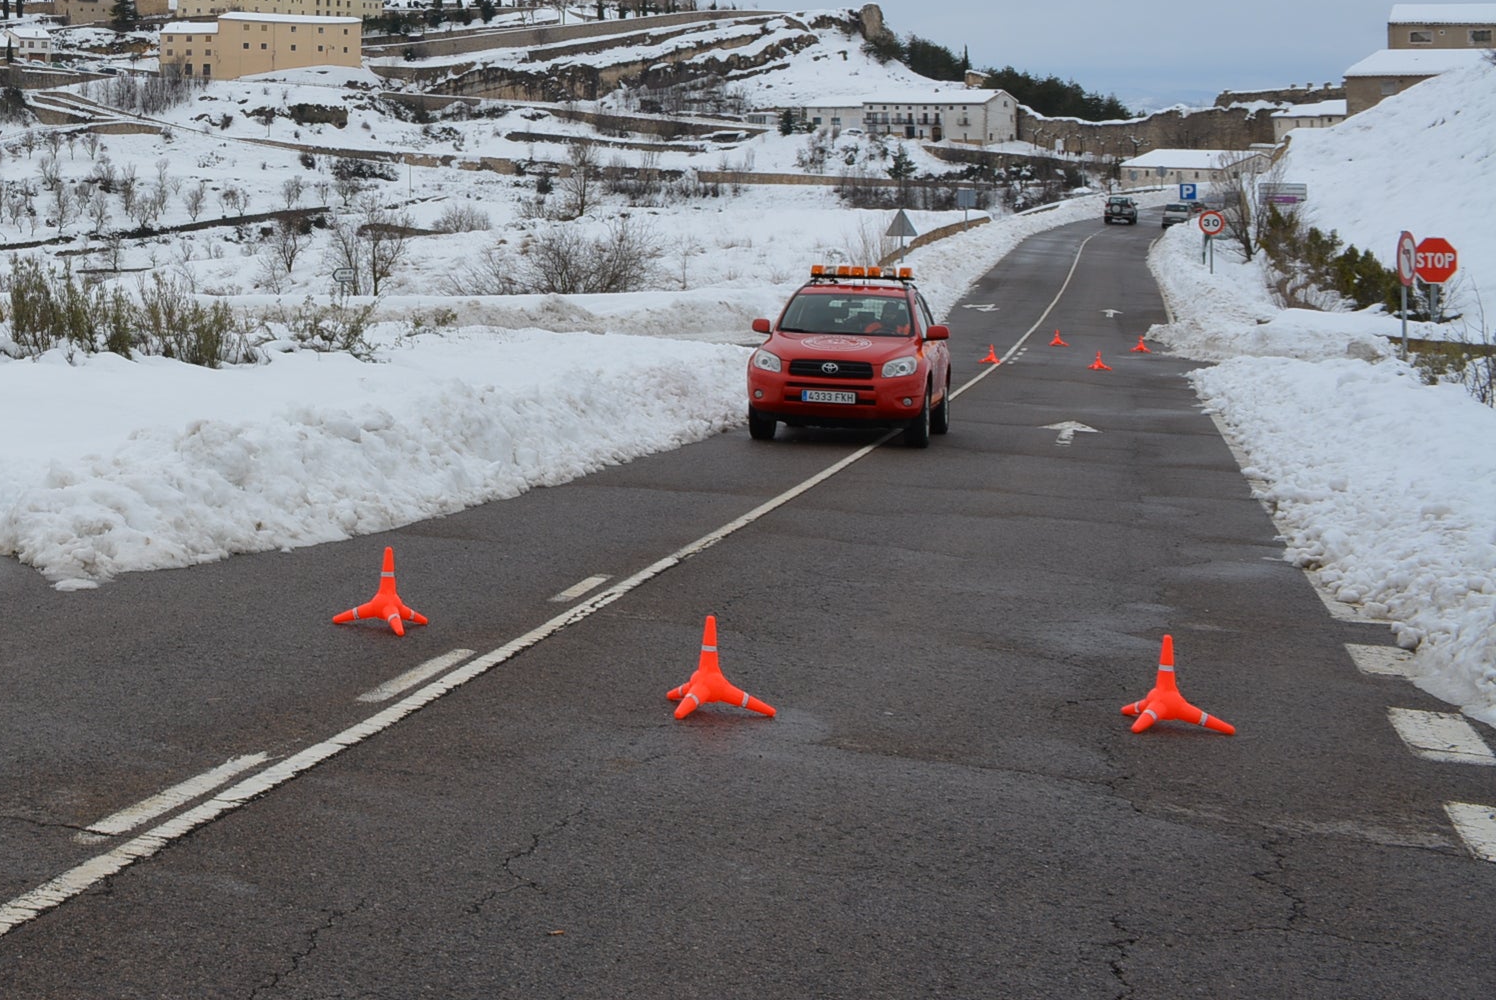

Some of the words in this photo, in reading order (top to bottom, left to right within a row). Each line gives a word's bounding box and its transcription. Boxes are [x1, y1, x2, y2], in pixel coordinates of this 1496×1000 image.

[1182, 185, 1194, 198] P
[1203, 218, 1220, 227] 30
[1416, 252, 1455, 269] STOP
[808, 391, 833, 401] 4333
[834, 392, 854, 403] FKH
